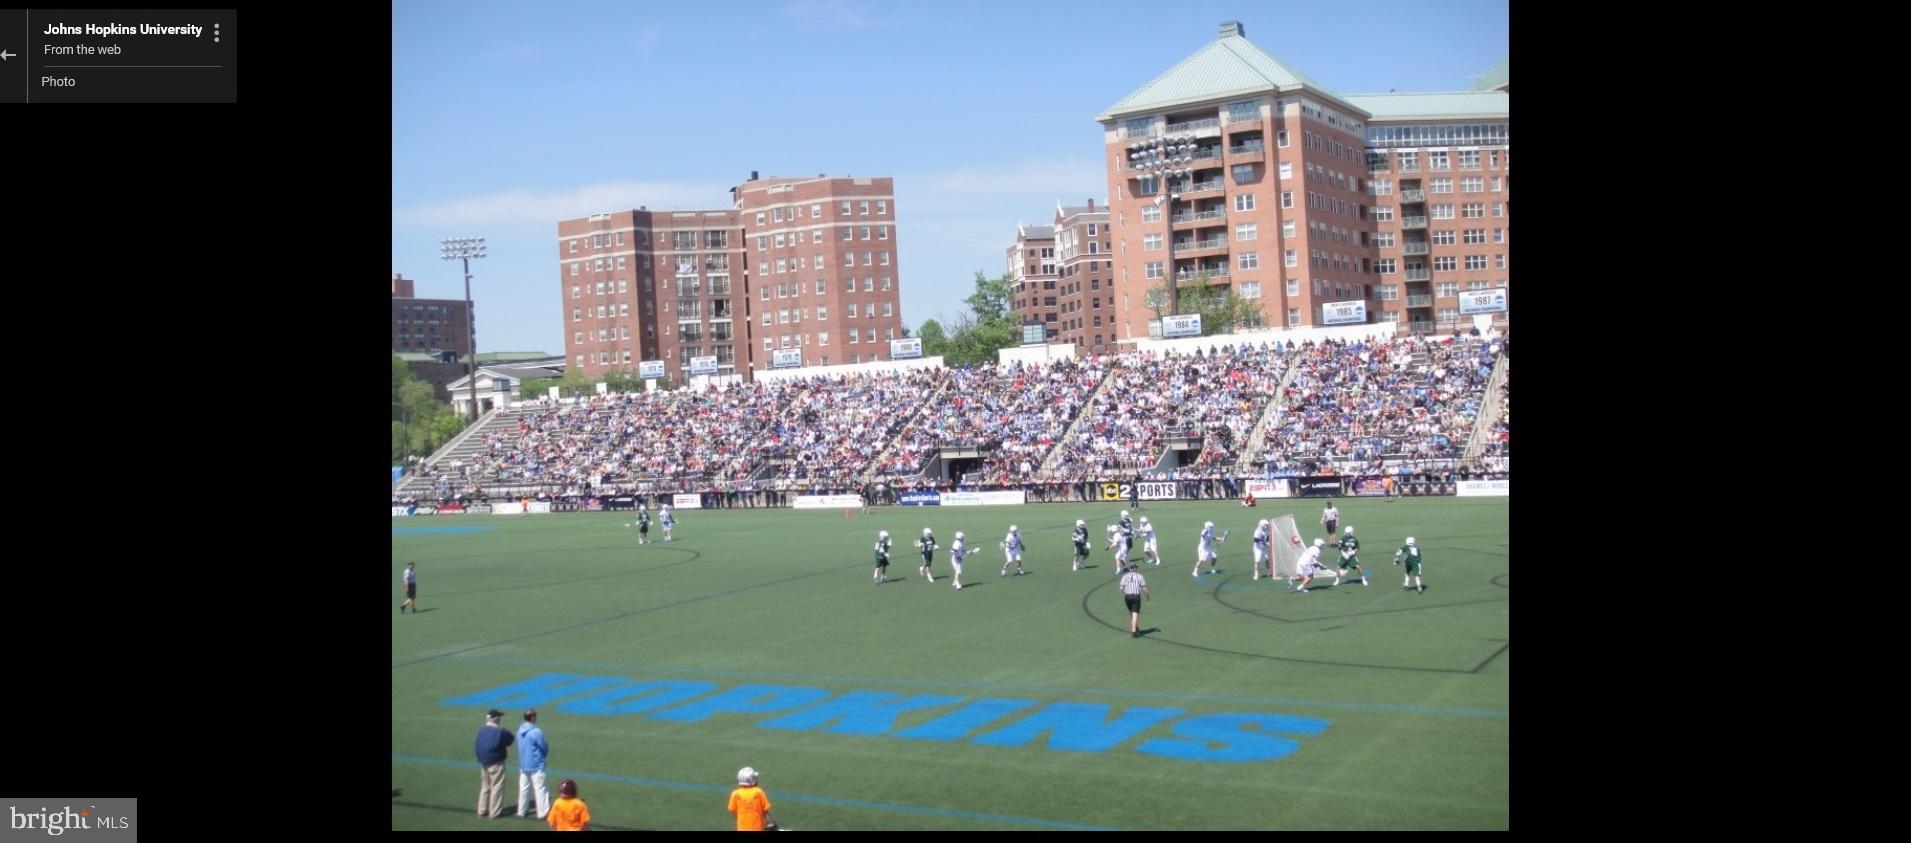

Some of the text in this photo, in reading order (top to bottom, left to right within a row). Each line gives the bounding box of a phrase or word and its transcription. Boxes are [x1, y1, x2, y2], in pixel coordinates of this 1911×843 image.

[1475, 295, 1492, 306] 1987
[1336, 306, 1353, 317] 1985
[1174, 320, 1190, 329] 1984
[1119, 484, 1131, 498] 2
[1138, 484, 1174, 498] PORTS
[443, 672, 1332, 763] HOPKINS
